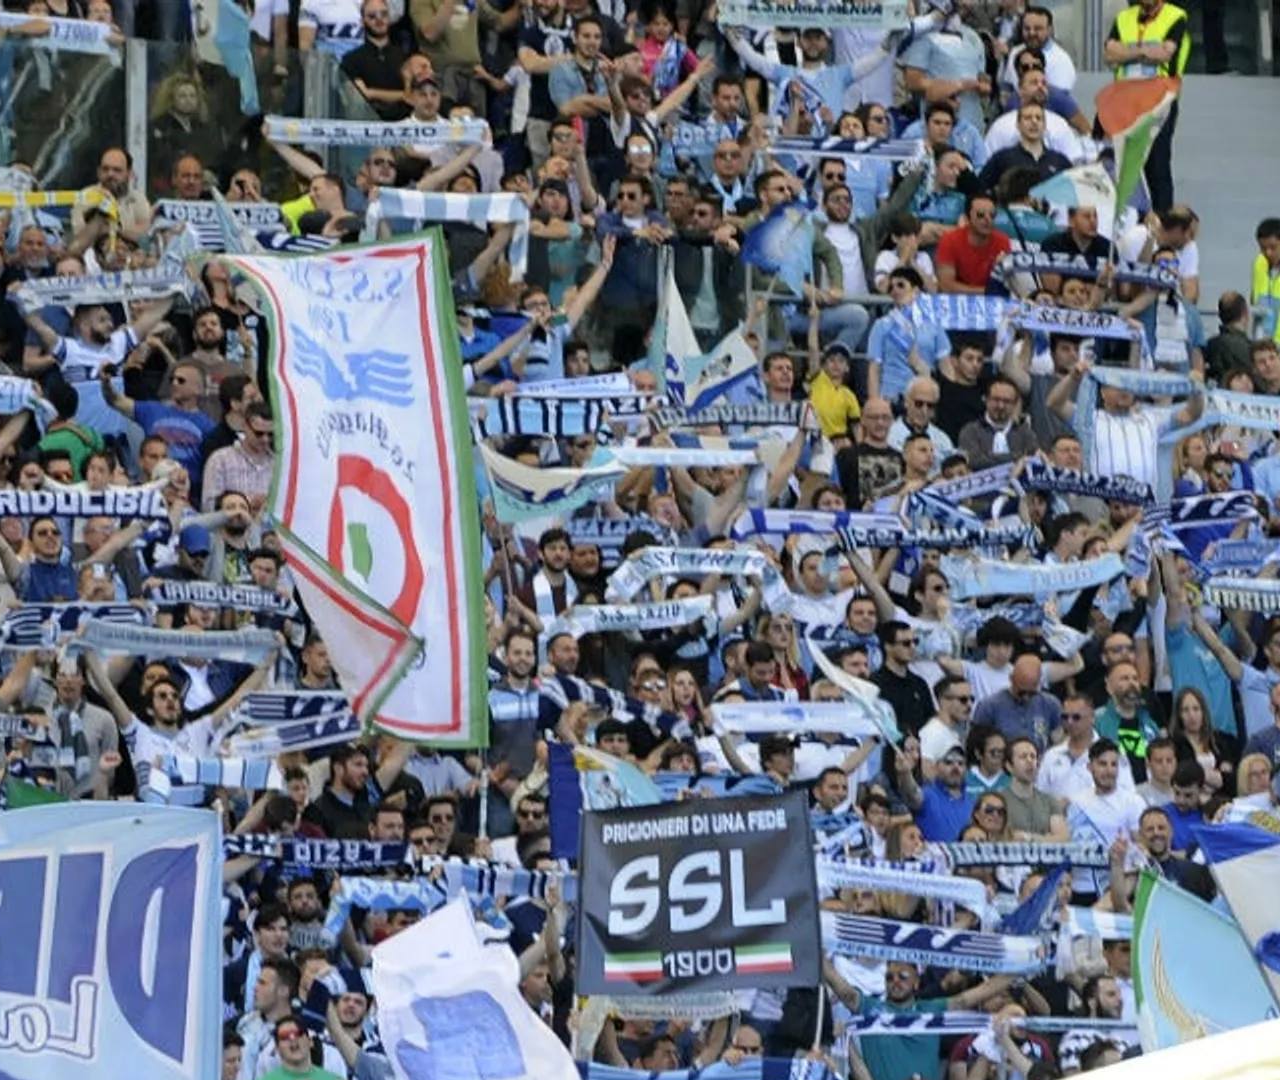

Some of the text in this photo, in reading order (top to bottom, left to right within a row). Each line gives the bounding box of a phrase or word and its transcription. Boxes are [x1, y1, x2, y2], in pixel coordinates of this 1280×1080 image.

[365, 125, 438, 138] LAZIO
[232, 204, 283, 223] AZIO
[636, 604, 680, 621] LAZIO
[602, 808, 787, 844] PRIGIONIERI DI UNA FEDE
[608, 850, 787, 937] SSL
[662, 947, 734, 979] 1900
